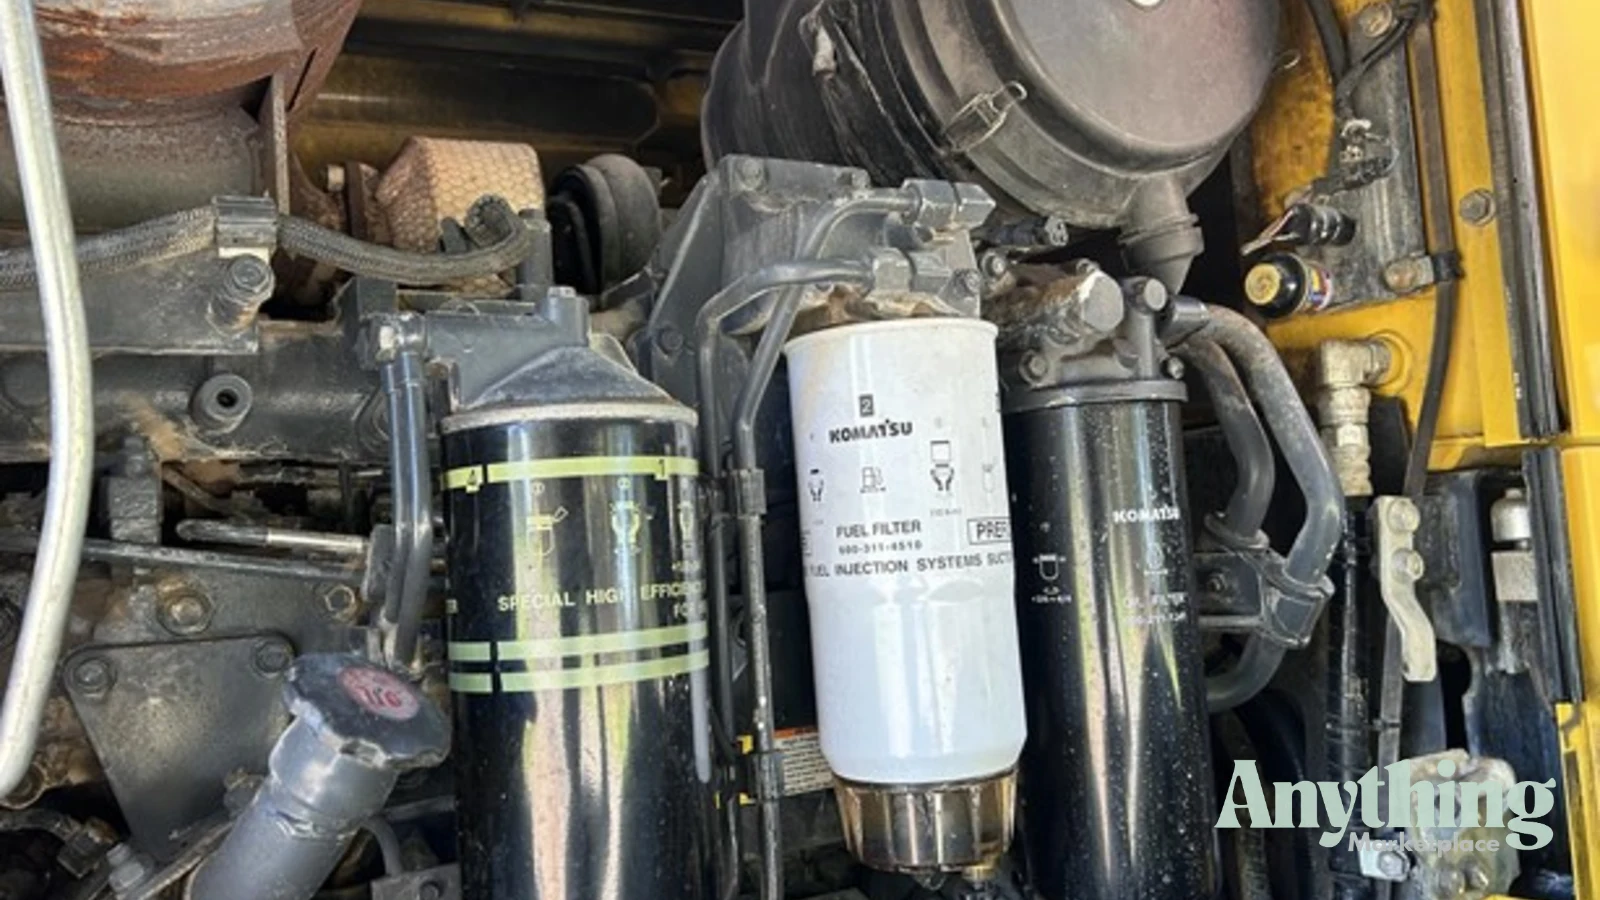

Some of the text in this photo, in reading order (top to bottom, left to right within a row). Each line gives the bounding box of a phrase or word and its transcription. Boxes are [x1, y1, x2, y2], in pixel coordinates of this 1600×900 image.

[829, 419, 914, 443] KOMATSU
[836, 519, 922, 539] FUEL FILTER
[835, 559, 908, 576] INJECTION
[917, 553, 982, 572] SYSTEMS
[497, 591, 576, 612] SPECIAL
